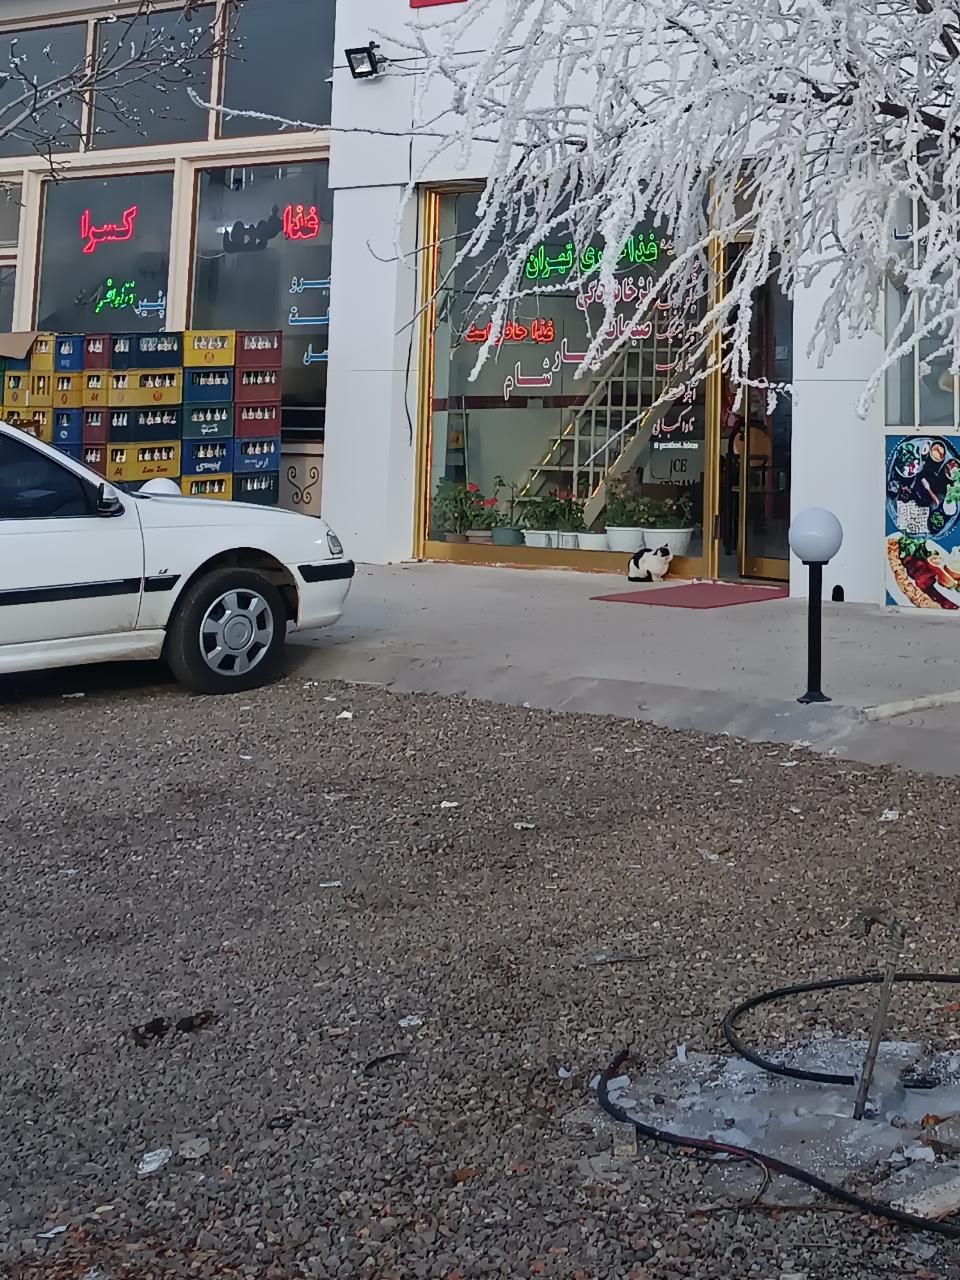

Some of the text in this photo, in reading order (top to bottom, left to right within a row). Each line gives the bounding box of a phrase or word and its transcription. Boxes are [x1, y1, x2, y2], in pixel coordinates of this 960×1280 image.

[525, 244, 573, 279] تهران
[576, 276, 639, 311] خاندگی
[494, 320, 528, 347] حاض
[531, 318, 555, 344] غذا
[503, 358, 554, 401] شام
